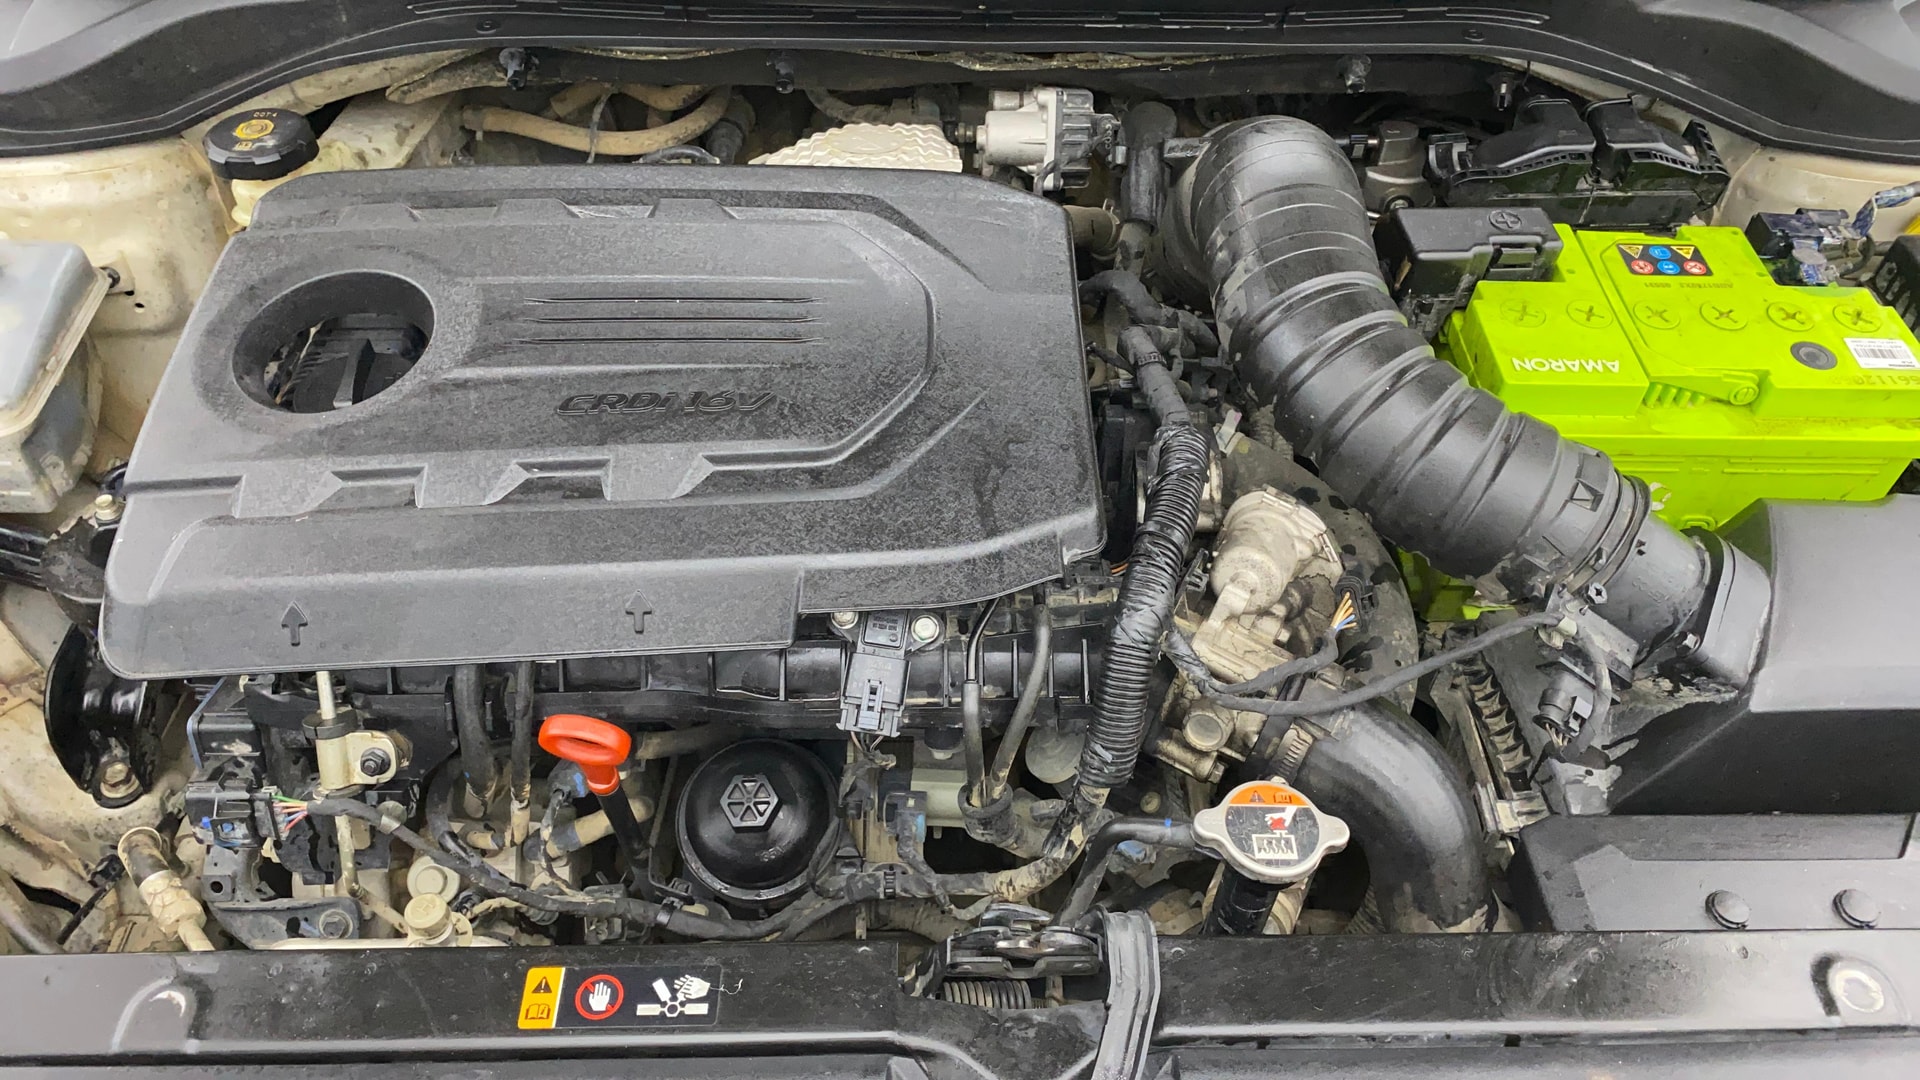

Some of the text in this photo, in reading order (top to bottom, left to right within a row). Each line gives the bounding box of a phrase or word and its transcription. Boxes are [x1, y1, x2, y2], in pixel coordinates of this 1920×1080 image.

[1511, 357, 1620, 373] AMARON
[557, 391, 776, 416] CRDi 16V
